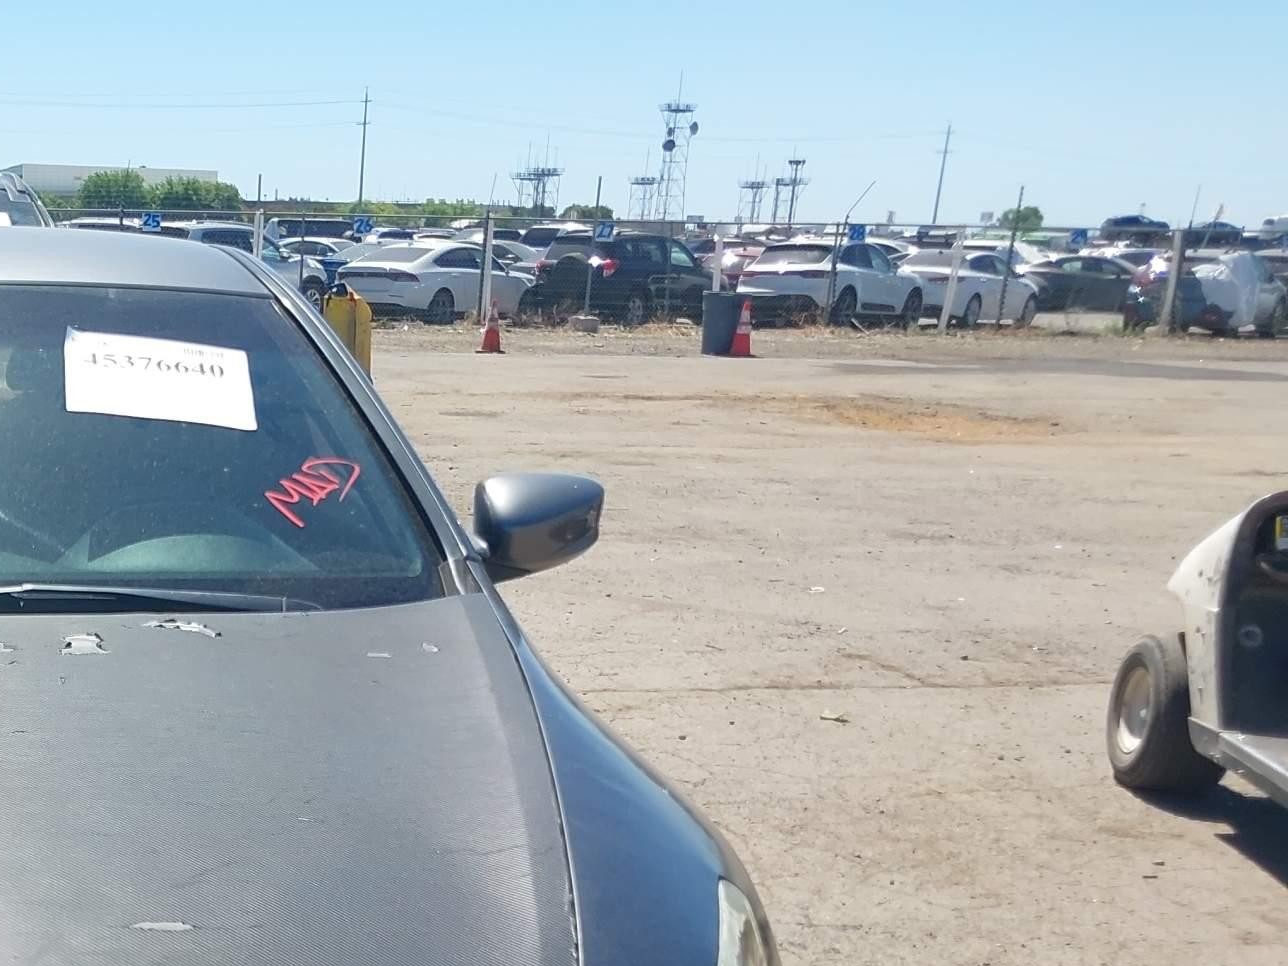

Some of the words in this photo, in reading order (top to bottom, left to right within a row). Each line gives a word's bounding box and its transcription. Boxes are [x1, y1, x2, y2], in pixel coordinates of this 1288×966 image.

[143, 213, 161, 228] 25
[354, 217, 373, 233] 26
[83, 352, 225, 379] 45376640
